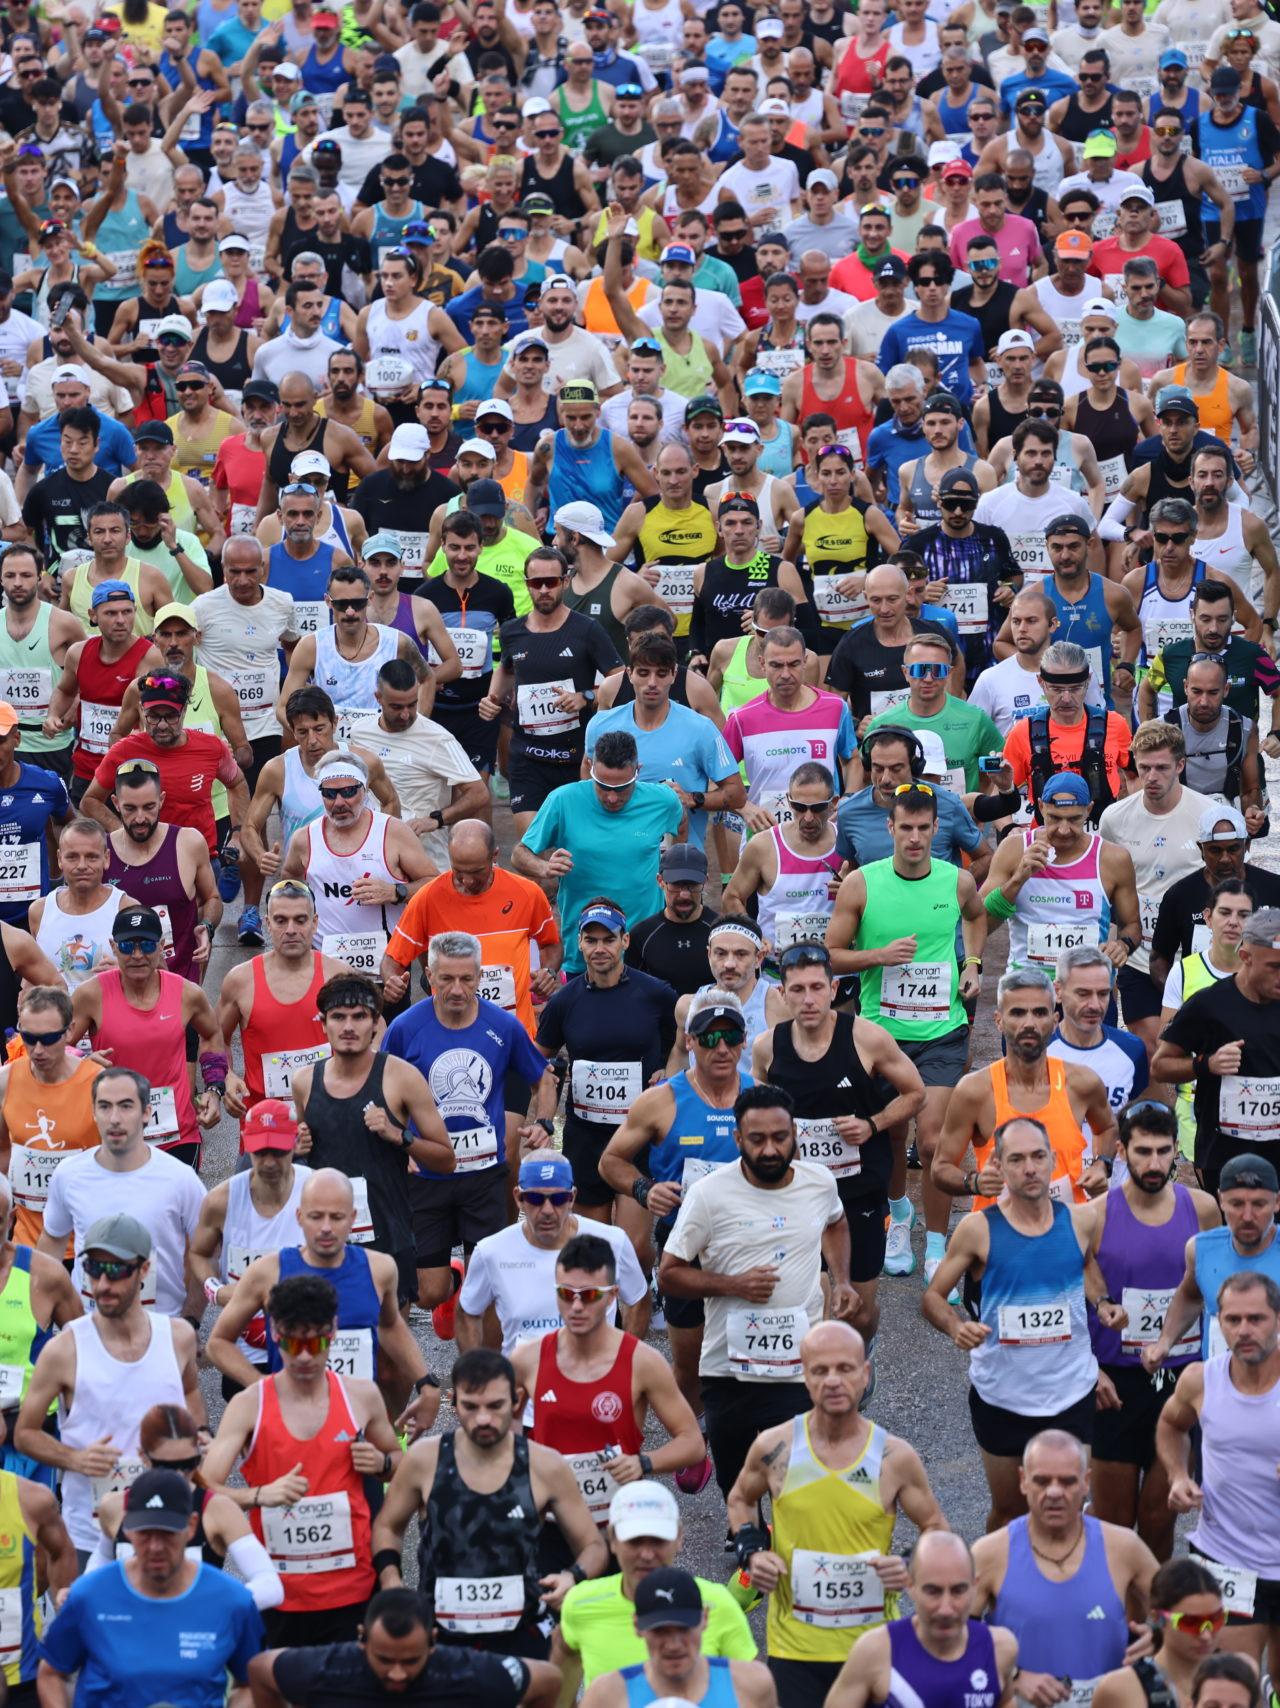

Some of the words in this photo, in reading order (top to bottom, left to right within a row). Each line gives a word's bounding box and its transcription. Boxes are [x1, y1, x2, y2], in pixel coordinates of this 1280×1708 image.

[378, 371, 401, 381] 1007
[1012, 551, 1043, 563] 2091
[496, 564, 514, 574] USC
[663, 584, 694, 597] 2032
[6, 686, 40, 698] 4136
[1044, 934, 1084, 949] 1164
[897, 984, 937, 999] 1744
[586, 1084, 626, 1100] 2104
[1238, 1102, 1280, 1117] 1705
[800, 1144, 843, 1159] 1836
[1018, 1310, 1064, 1329] 1322
[745, 1334, 793, 1351] 7476
[283, 1525, 332, 1543] 1562
[454, 1583, 504, 1600] 1332
[813, 1581, 865, 1600] 1553
